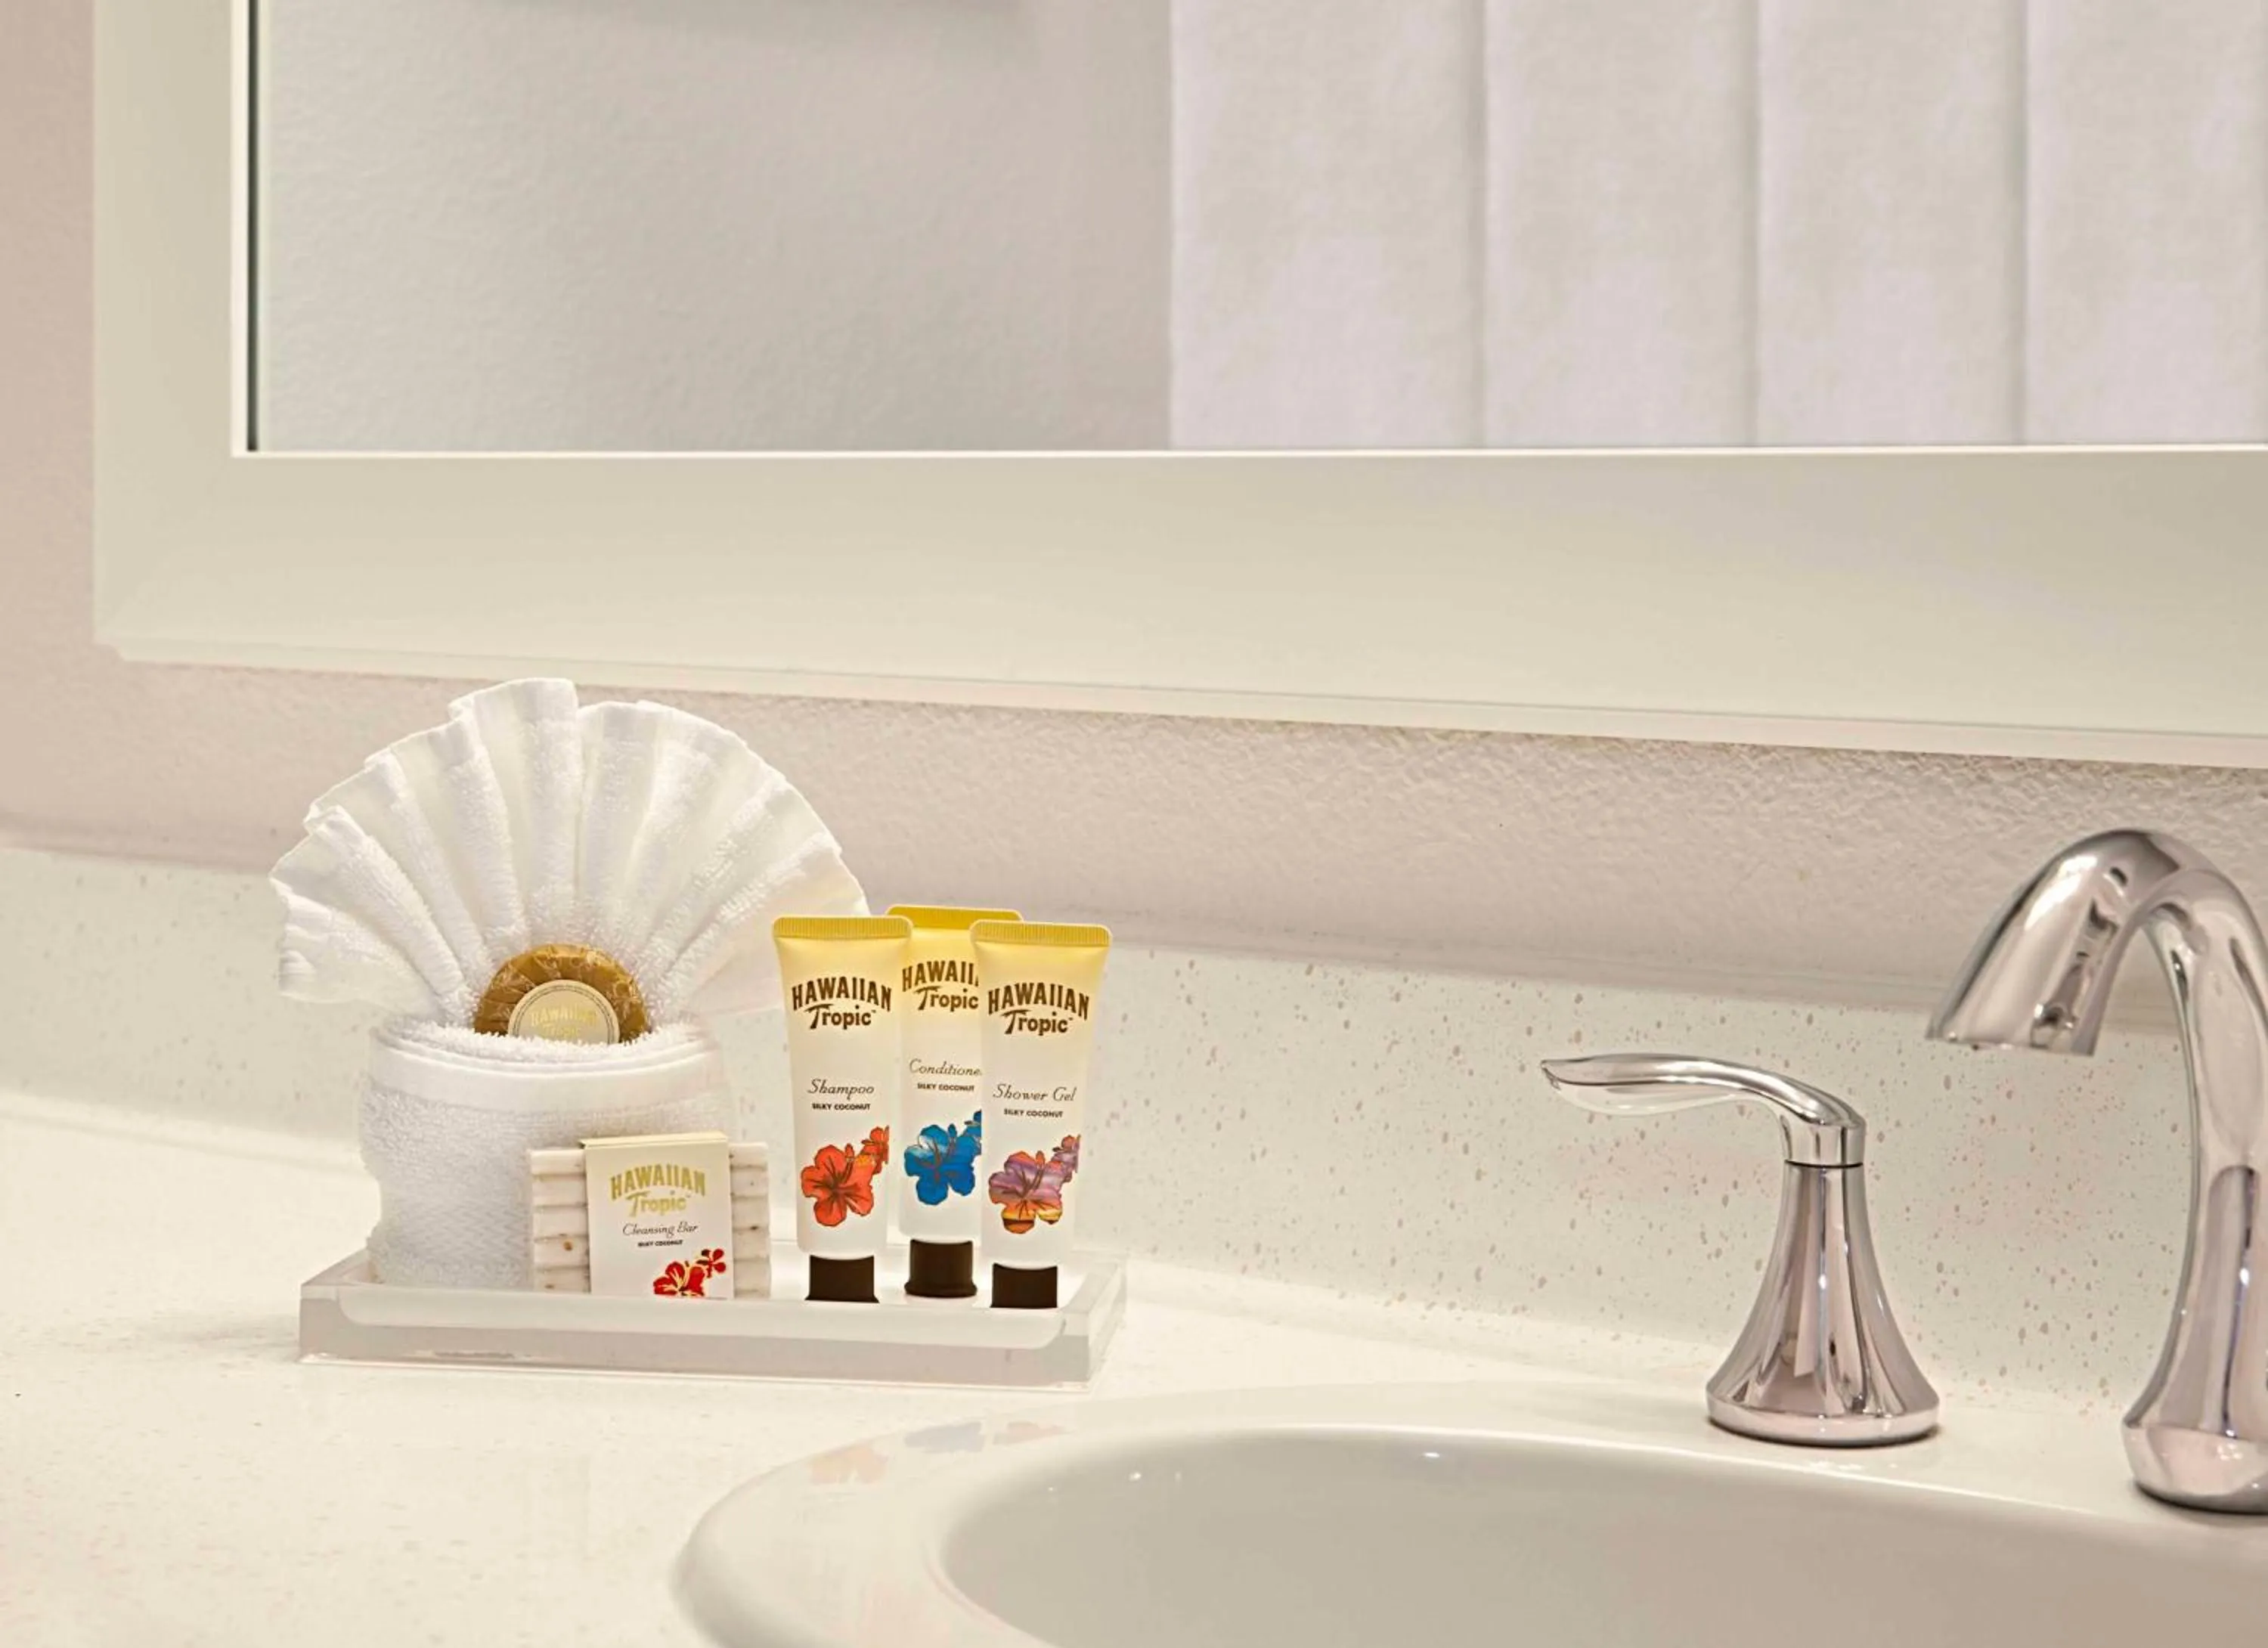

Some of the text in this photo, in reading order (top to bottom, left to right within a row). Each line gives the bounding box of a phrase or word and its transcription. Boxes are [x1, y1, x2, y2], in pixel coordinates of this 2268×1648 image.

[902, 960, 979, 992] HAWAII
[792, 976, 892, 1012] HAWAIIAN
[913, 985, 979, 1012] Tropic
[988, 982, 1089, 1021] HAWAIIAN
[804, 1003, 872, 1030] Tropic
[1001, 1008, 1068, 1036] Tropic
[909, 1058, 983, 1076] Conditione
[807, 1078, 875, 1101] Shampoo
[993, 1083, 1077, 1102] Shower Gel
[1026, 1110, 1064, 1118] COCONUT
[610, 1163, 705, 1201] HAWAIIAN
[625, 1190, 686, 1217] Tropic
[622, 1221, 699, 1239] Cleansing Bar
